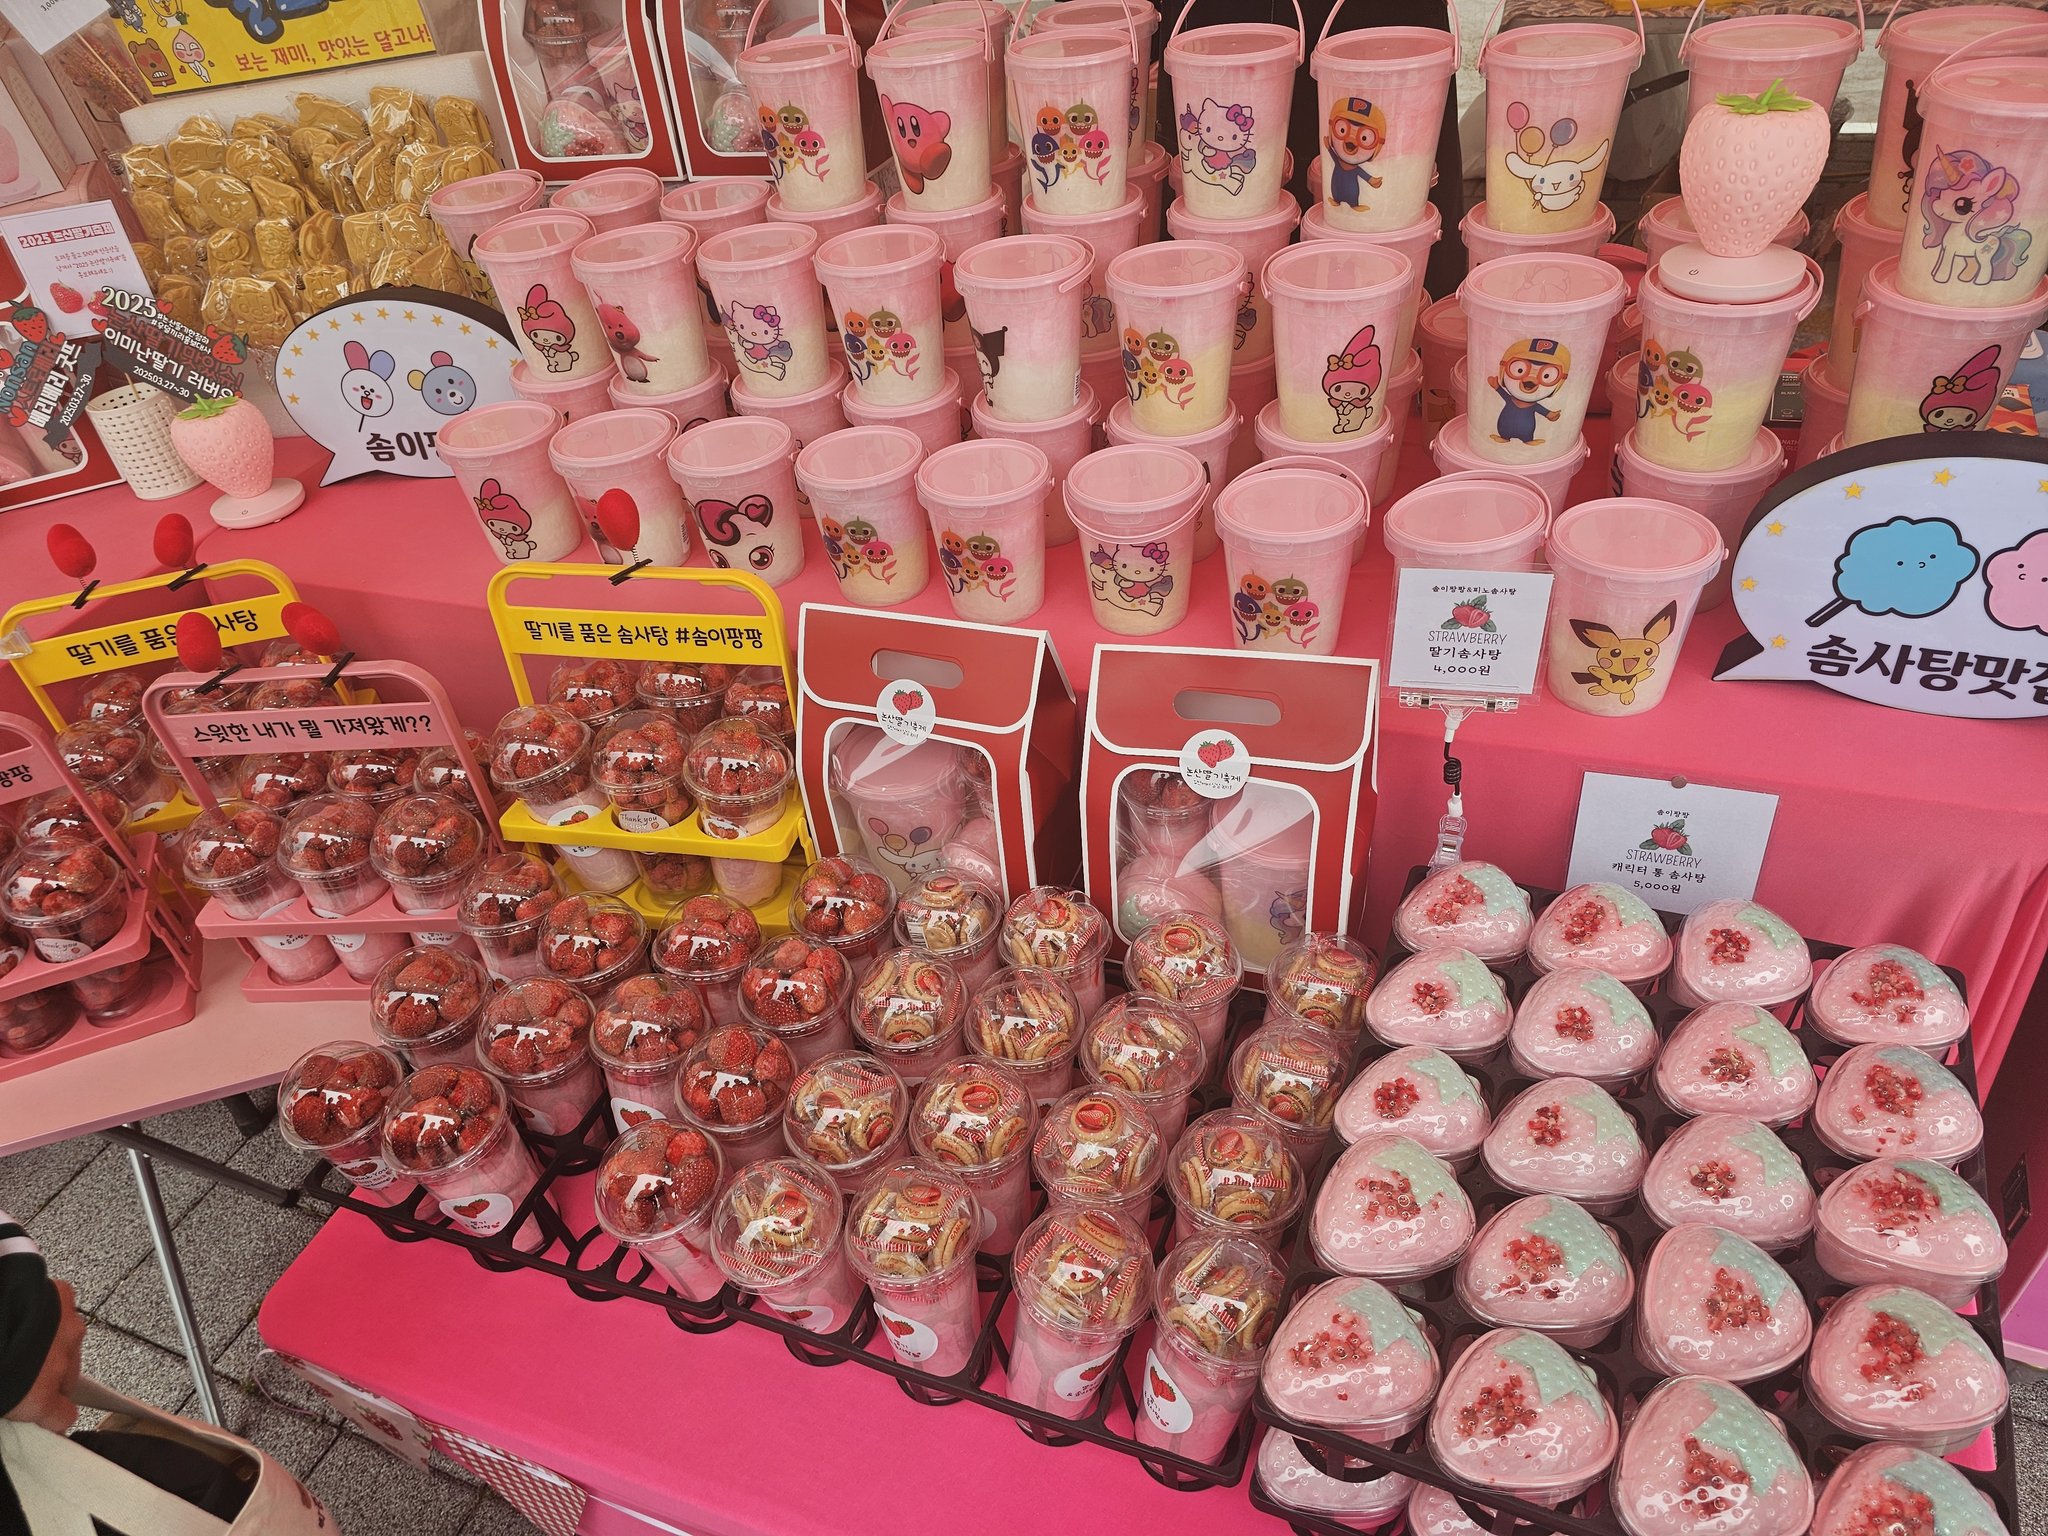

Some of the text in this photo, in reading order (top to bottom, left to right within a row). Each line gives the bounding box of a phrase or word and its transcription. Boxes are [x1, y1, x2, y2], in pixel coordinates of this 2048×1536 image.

[235, 23, 432, 72] 보는 재미!, 맛있는 달고나!
[20, 233, 52, 248] 2025
[101, 286, 157, 318] 2025
[104, 328, 184, 378] 이미난딸기
[28, 370, 69, 428] 베리베리
[66, 633, 140, 666] 딸기를
[213, 609, 259, 633] 사탕
[524, 620, 763, 650] 딸기를 품은 솜사탕 #솜이팡팡
[1428, 630, 1508, 645] STRAWBERRY
[1429, 646, 1502, 661] 딸기솜사탕
[1434, 664, 1491, 676] 4,000원
[193, 714, 432, 744] 스윗한 내가 뭘 가져왔게??
[1186, 766, 1241, 784] 논산딸기축제
[620, 813, 643, 823] Thank
[643, 816, 657, 826] you
[1626, 849, 1703, 869] STRAWBERRY
[1611, 862, 1707, 884] 캐릭터 통 솜사탕
[1633, 880, 1681, 895] 5,000원
